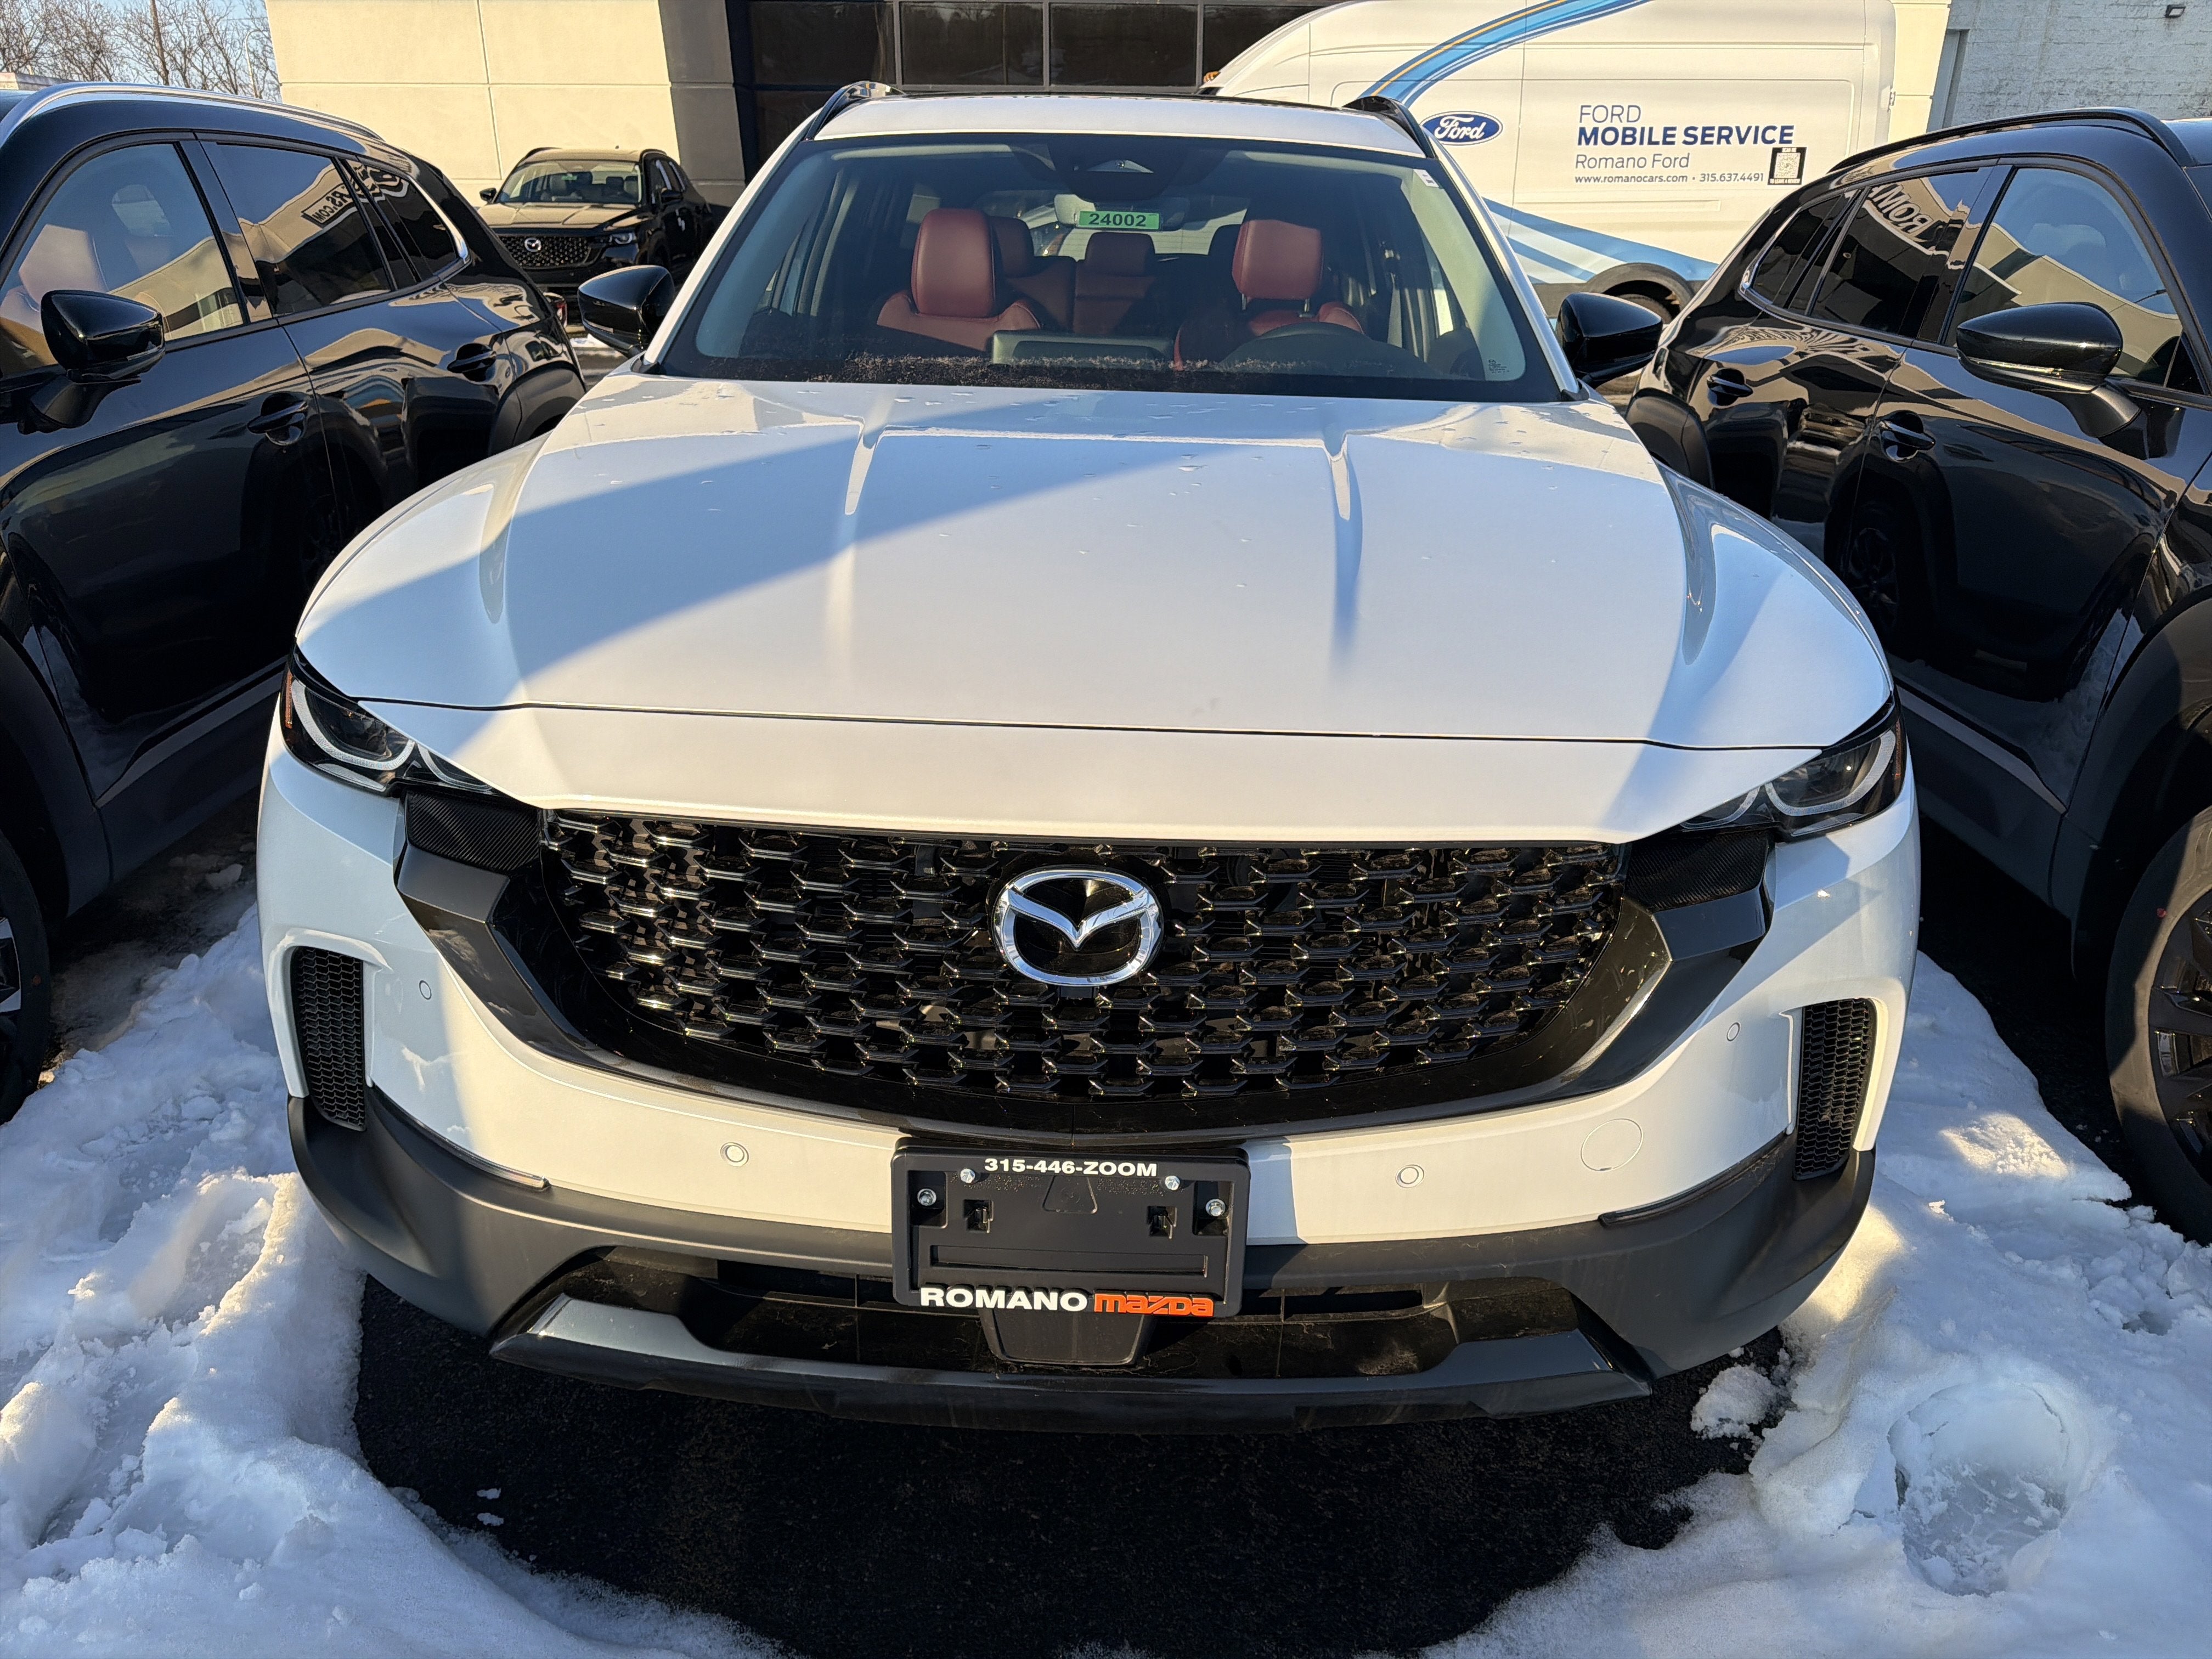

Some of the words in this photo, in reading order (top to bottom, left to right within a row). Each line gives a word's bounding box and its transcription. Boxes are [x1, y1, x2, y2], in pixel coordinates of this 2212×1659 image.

[1579, 105, 1641, 123] FORD
[1434, 116, 1487, 139] Ford
[1578, 126, 1677, 146] MOBILE
[1682, 125, 1795, 145] SERVICE
[1575, 154, 1647, 169] Romano
[1651, 153, 1690, 168] Ford
[1575, 174, 1688, 183] www.romanocars.com
[1699, 173, 1764, 182] 315.637.4491
[1088, 213, 1147, 227] 24002
[984, 1158, 1157, 1177] 315-446-ZOOM
[920, 1288, 1088, 1312] ROMANO
